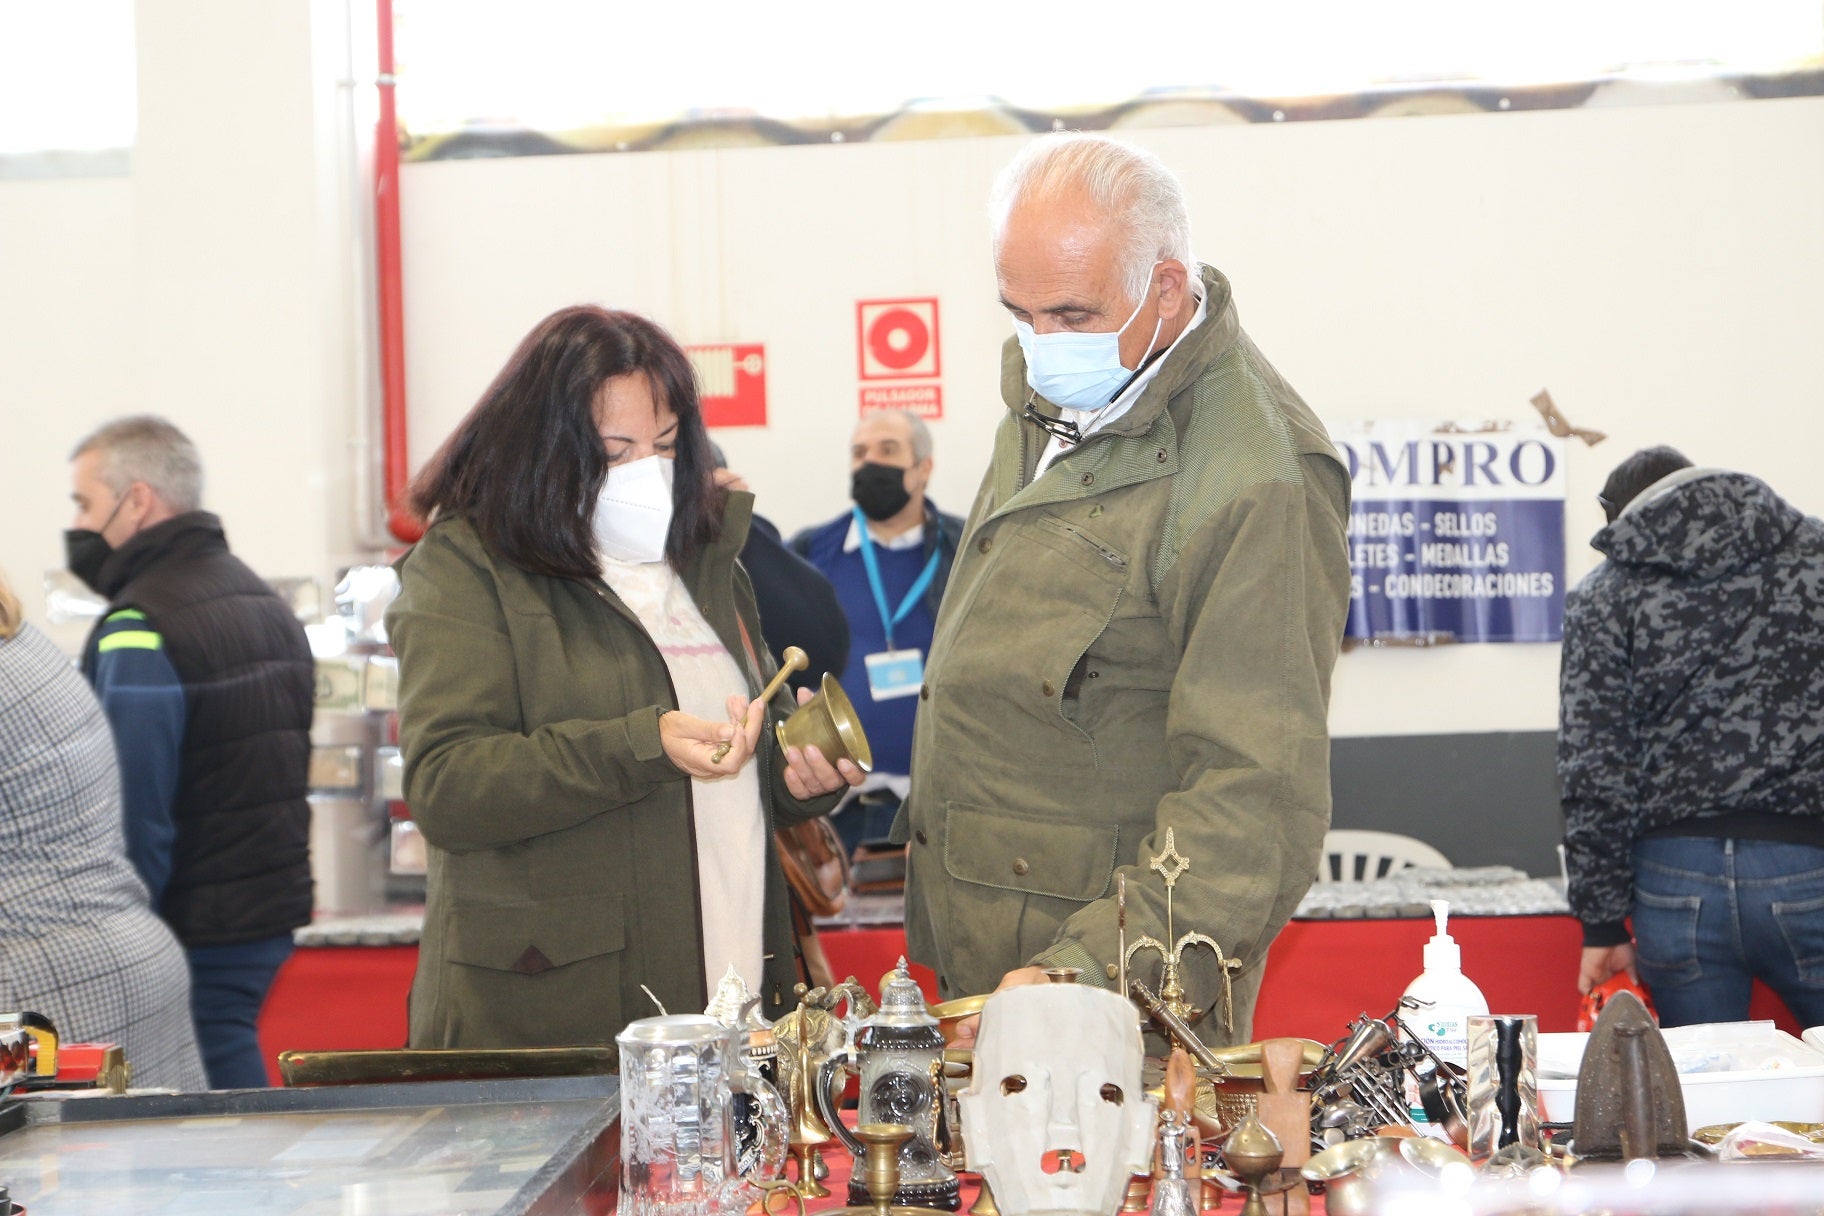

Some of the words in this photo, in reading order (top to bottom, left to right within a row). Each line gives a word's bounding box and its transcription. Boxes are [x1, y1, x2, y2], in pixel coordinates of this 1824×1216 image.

[865, 389, 935, 402] PULSADOR
[1434, 512, 1497, 537] SELLOS
[1422, 542, 1509, 567] MEDALLAS
[1385, 572, 1554, 600] CONDECORACIONES
